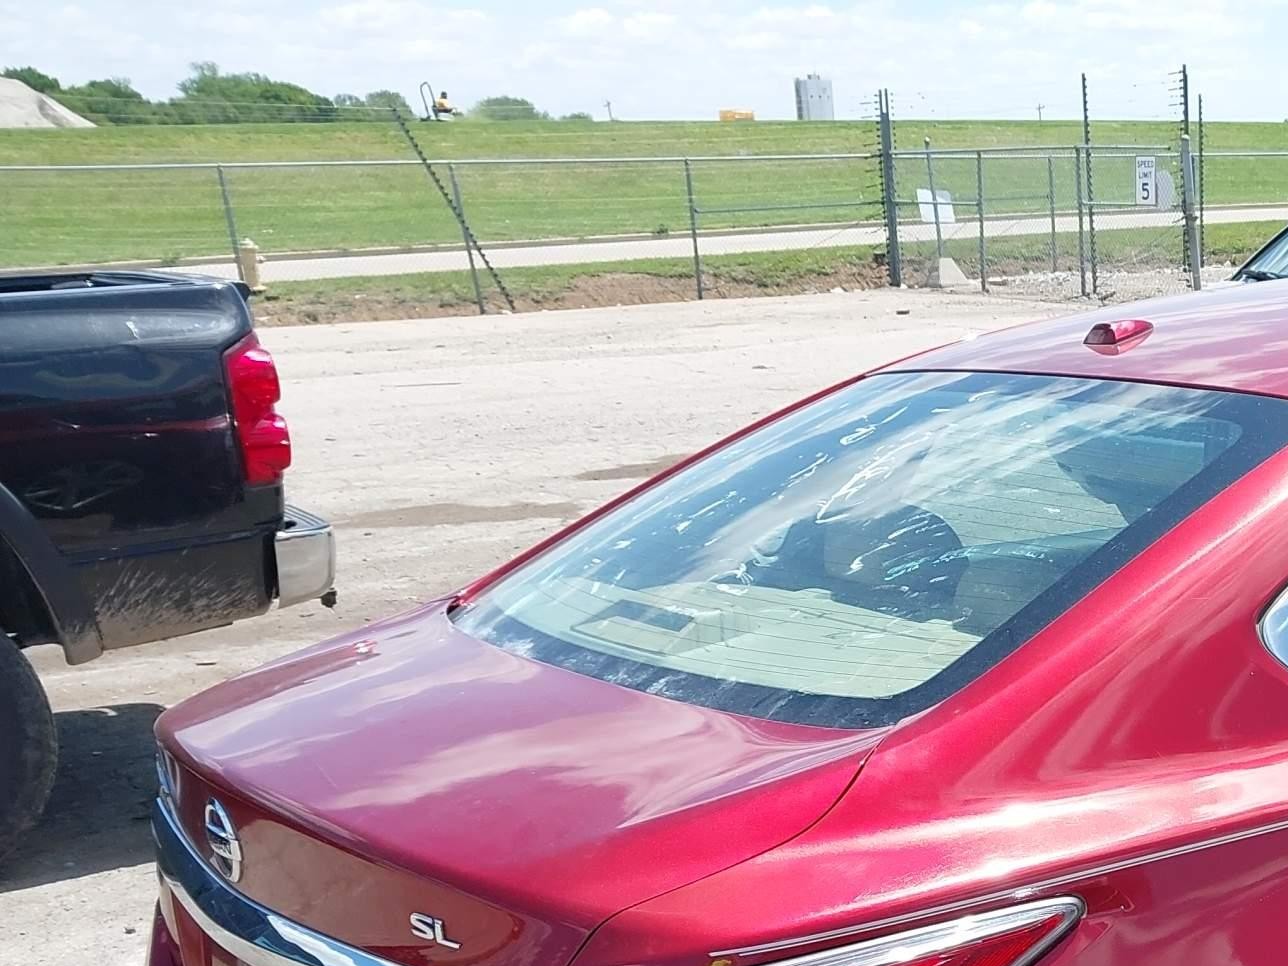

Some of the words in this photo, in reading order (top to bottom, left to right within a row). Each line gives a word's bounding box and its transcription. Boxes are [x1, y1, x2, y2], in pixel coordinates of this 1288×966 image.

[1137, 160, 1154, 168] SPEED
[1138, 171, 1152, 179] LIMIT
[1141, 182, 1150, 201] 5
[410, 912, 462, 950] SL
